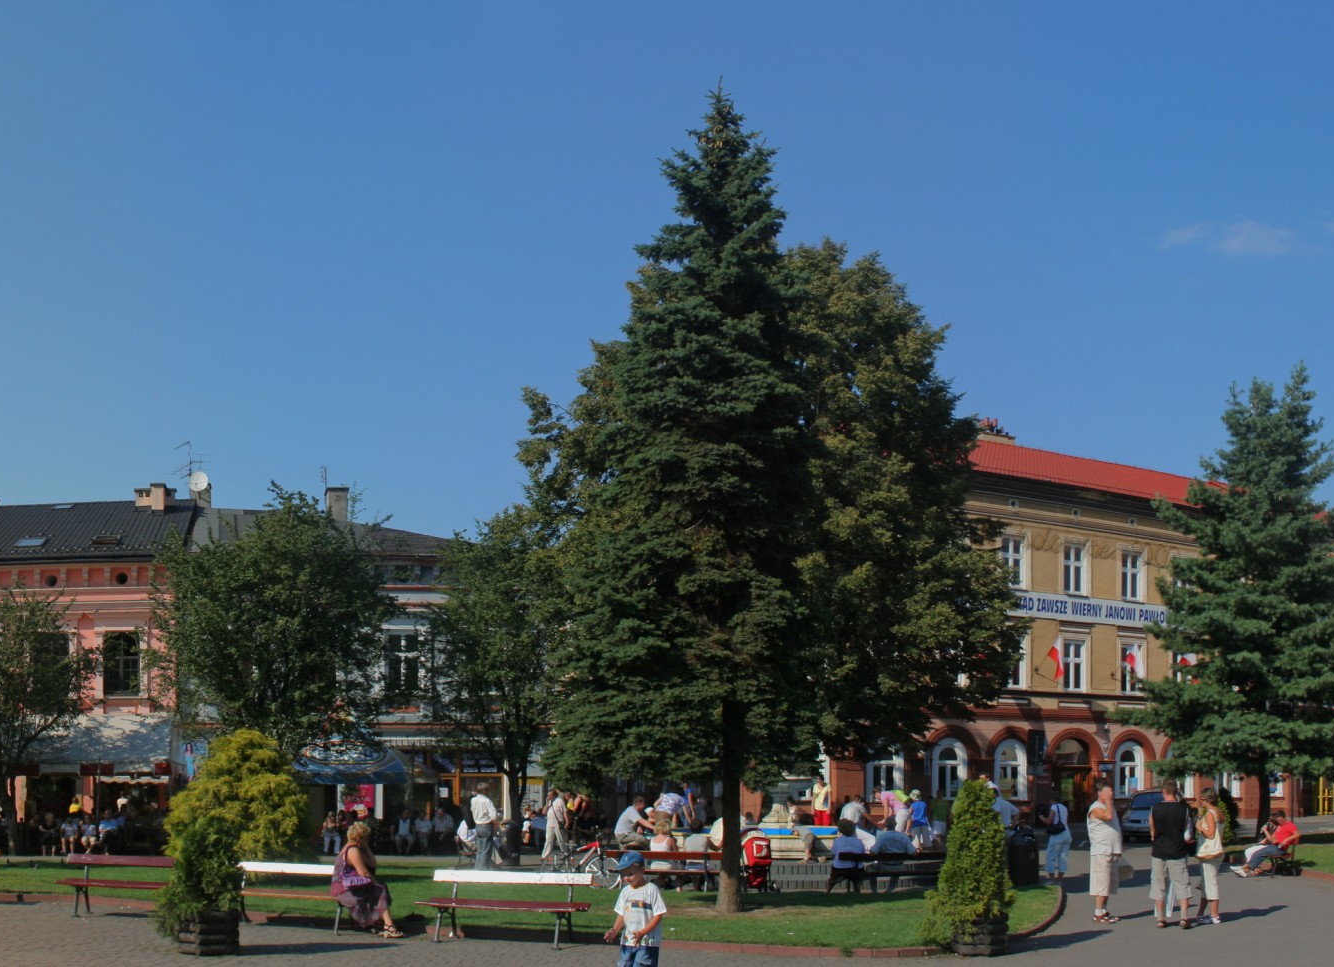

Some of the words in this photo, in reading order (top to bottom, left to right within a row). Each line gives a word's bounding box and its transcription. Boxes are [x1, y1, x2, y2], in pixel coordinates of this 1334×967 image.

[1036, 598, 1068, 614] ZAWSZE
[1071, 601, 1103, 617] WIERNY
[1104, 605, 1136, 621] JANOWI
